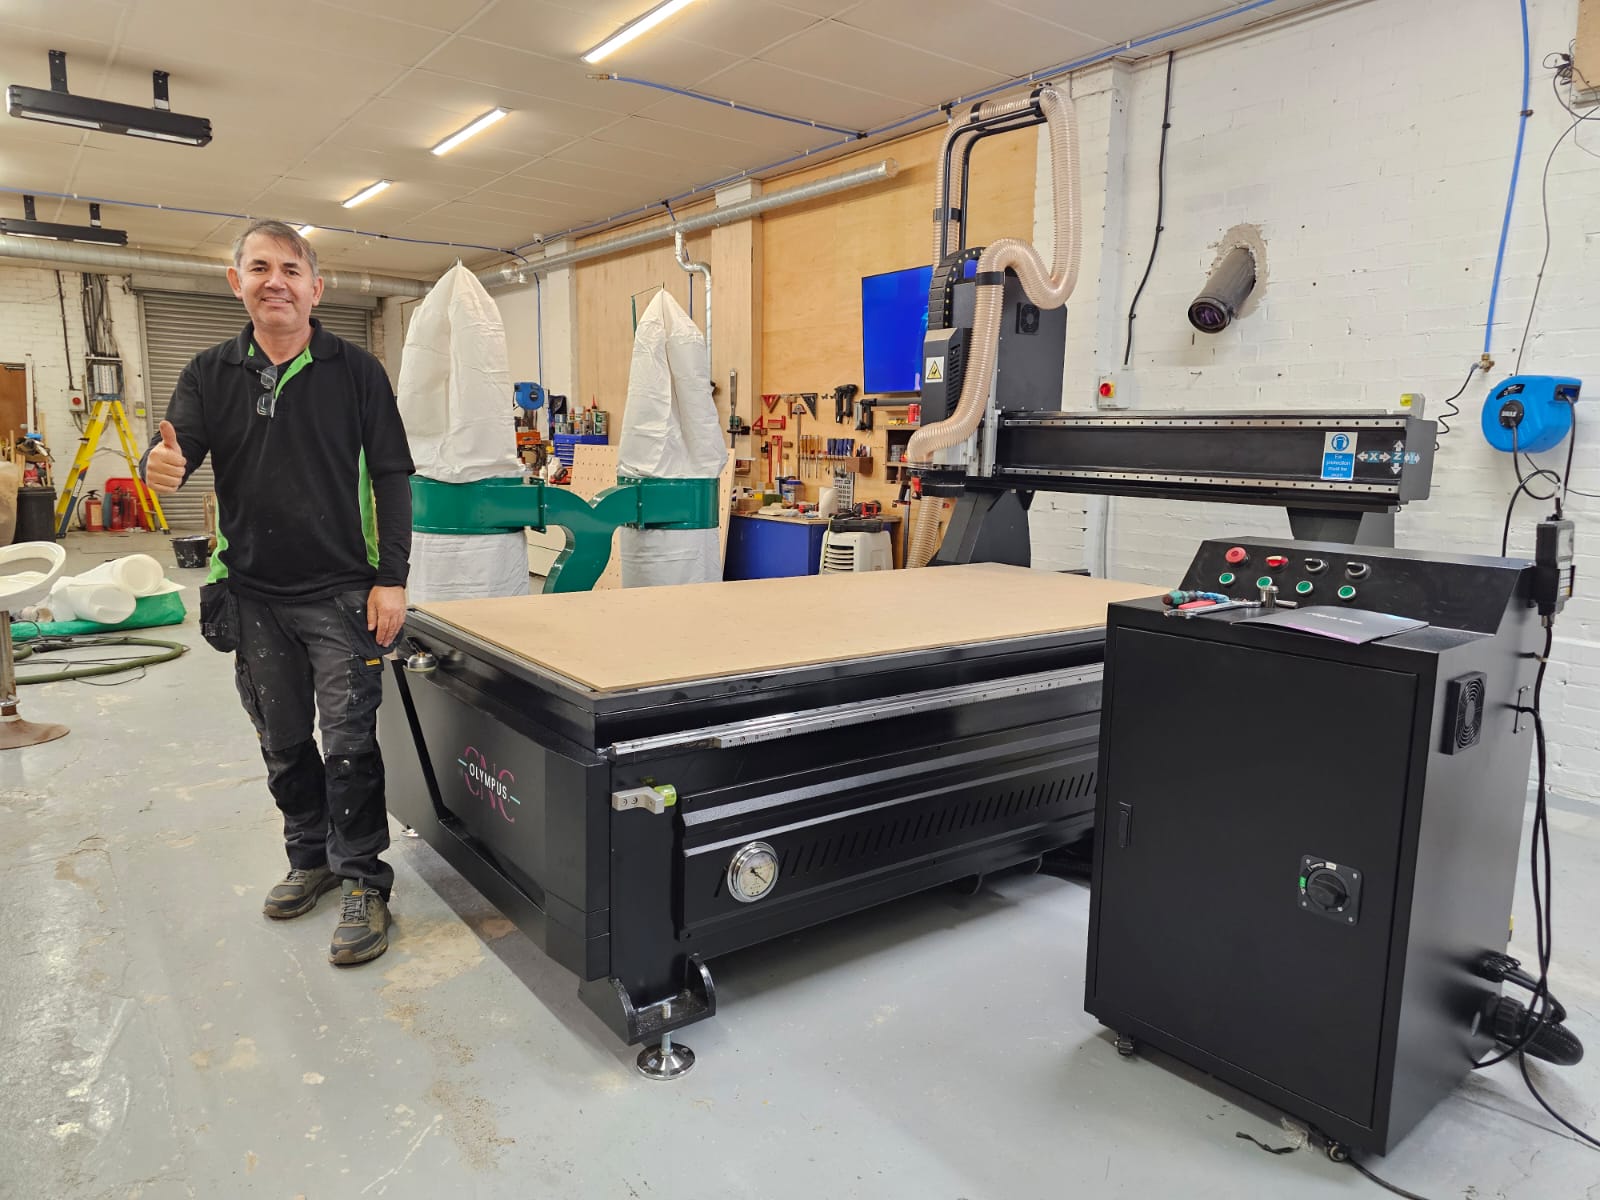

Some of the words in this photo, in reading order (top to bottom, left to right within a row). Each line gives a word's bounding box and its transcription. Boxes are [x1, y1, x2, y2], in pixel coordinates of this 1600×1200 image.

[1369, 452, 1378, 461] X
[1393, 452, 1403, 460] Z
[469, 762, 507, 800] OLYMPUS
